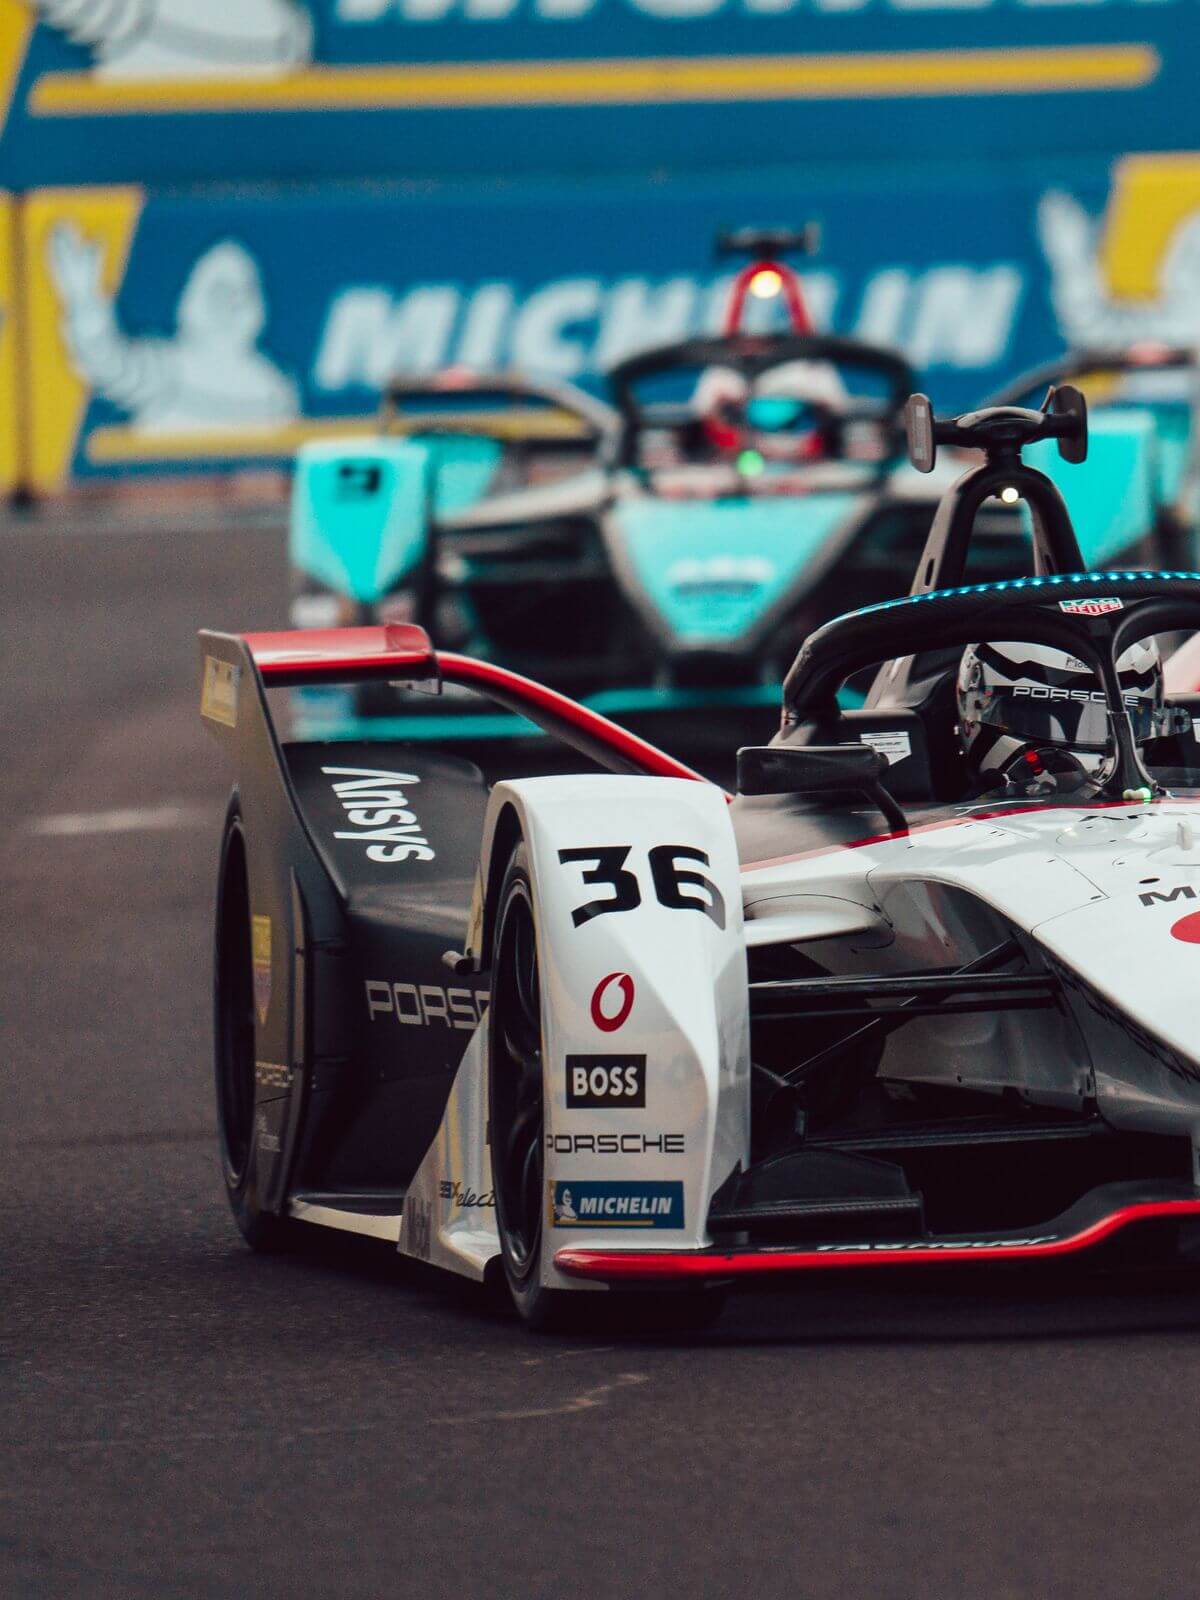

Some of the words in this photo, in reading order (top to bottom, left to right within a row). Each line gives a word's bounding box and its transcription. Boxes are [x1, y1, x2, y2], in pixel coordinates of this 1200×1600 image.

[1012, 686, 1139, 706] PORSCE
[320, 766, 436, 862] Ansys
[557, 844, 726, 930] 36
[572, 1066, 639, 1096] BOSS
[579, 1197, 672, 1214] MICHELIN
